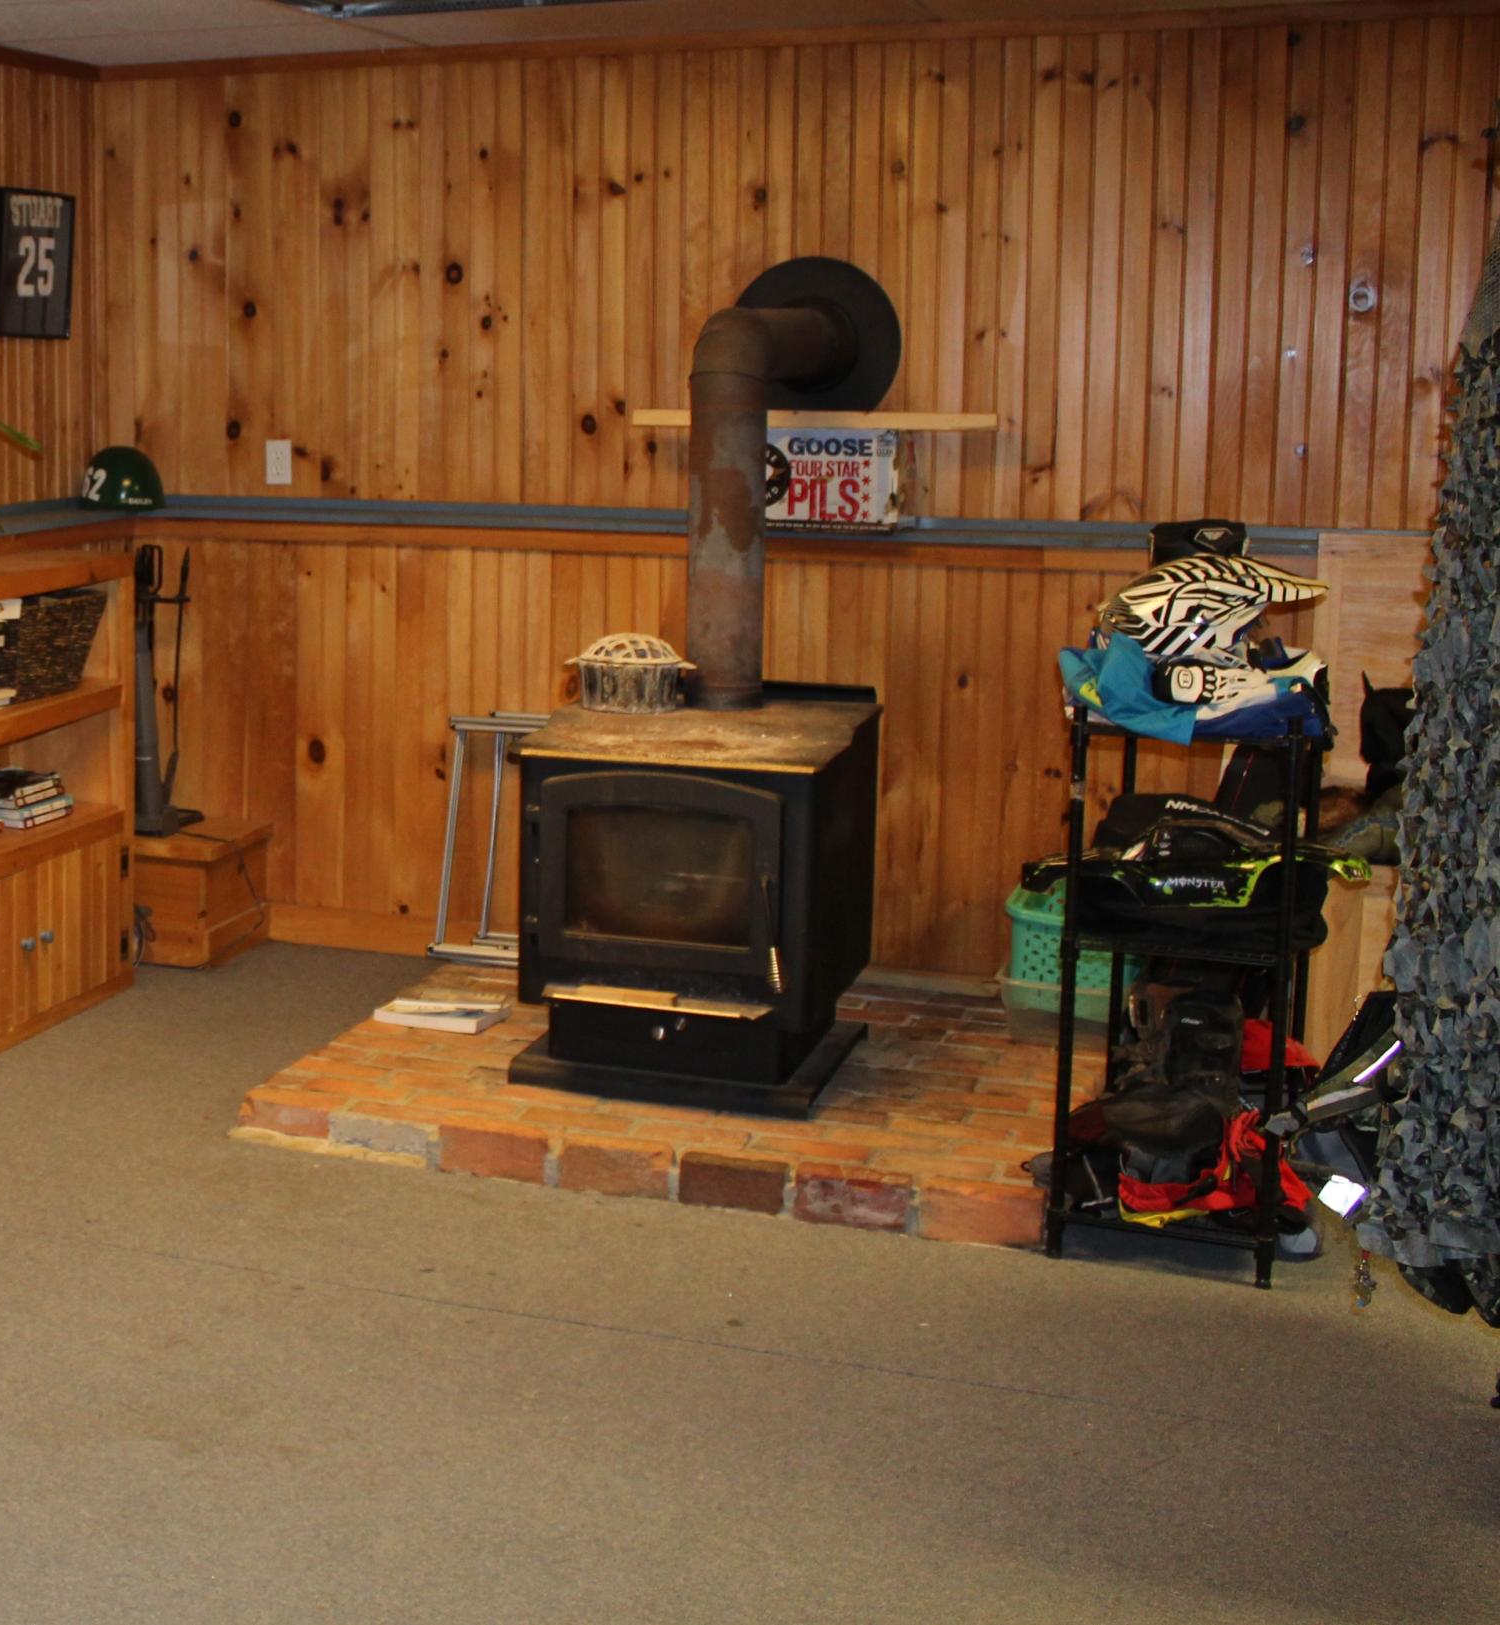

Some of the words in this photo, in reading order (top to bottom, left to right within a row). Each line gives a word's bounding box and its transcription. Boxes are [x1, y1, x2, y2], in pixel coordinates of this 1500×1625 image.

[9, 194, 63, 229] STUART
[17, 235, 56, 297] 25
[787, 436, 874, 458] GOOSE
[789, 459, 822, 477] FOUR
[826, 461, 861, 478] STAR
[787, 478, 861, 522] PILS
[1166, 876, 1229, 890] MONSTER
